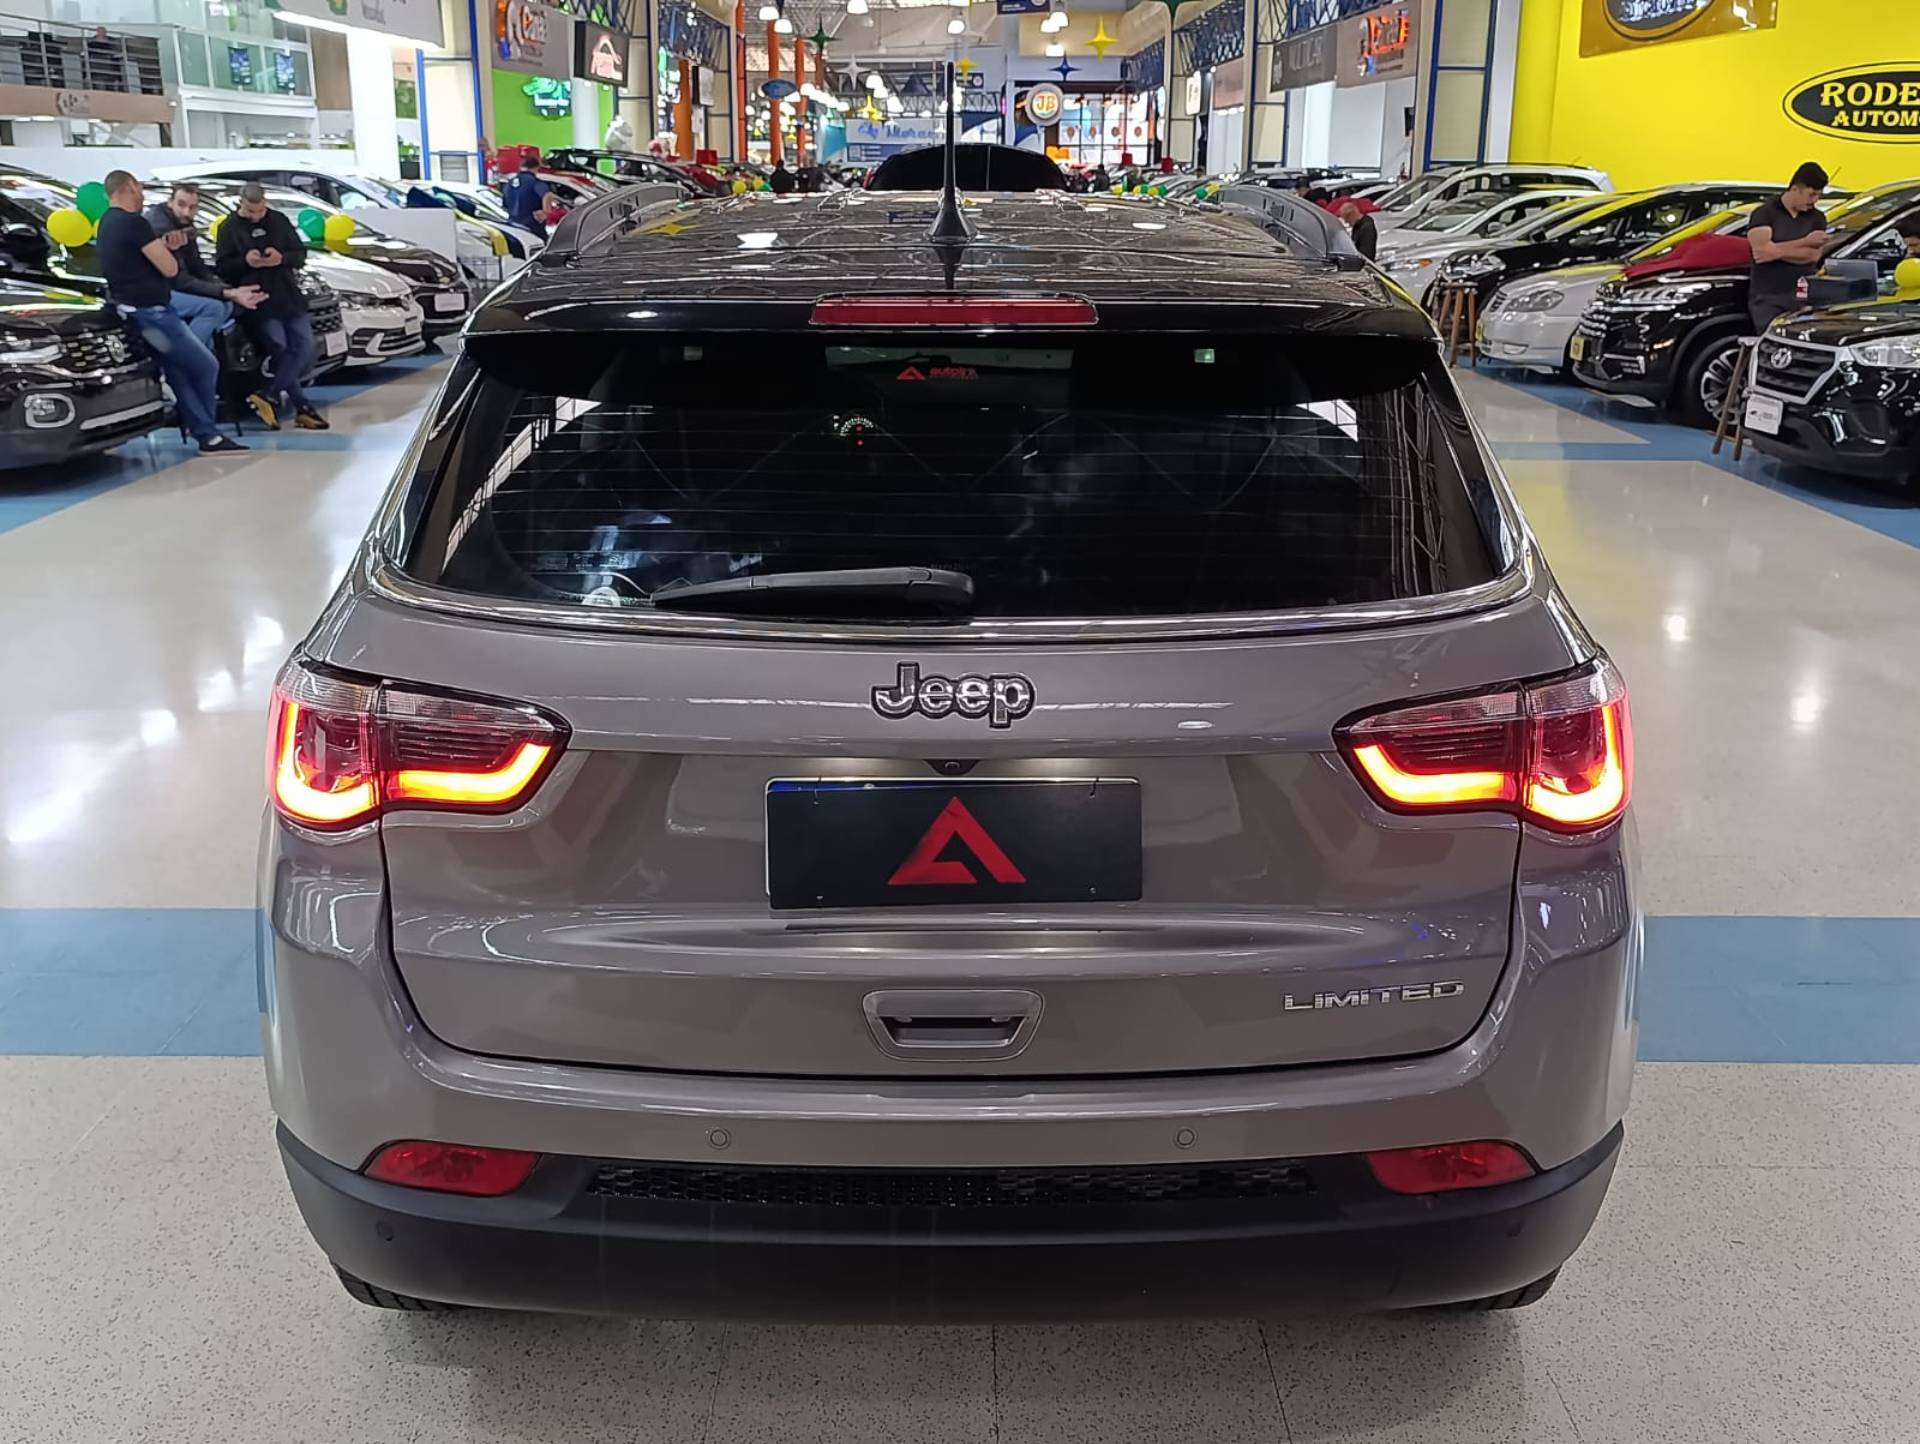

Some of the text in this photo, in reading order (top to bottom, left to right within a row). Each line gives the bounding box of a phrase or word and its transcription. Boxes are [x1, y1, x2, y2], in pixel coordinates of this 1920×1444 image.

[1820, 81, 1920, 108] RODE
[1831, 110, 1920, 127] AUTOM
[871, 661, 1036, 729] Jeep
[1283, 979, 1465, 1010] LIMITED
